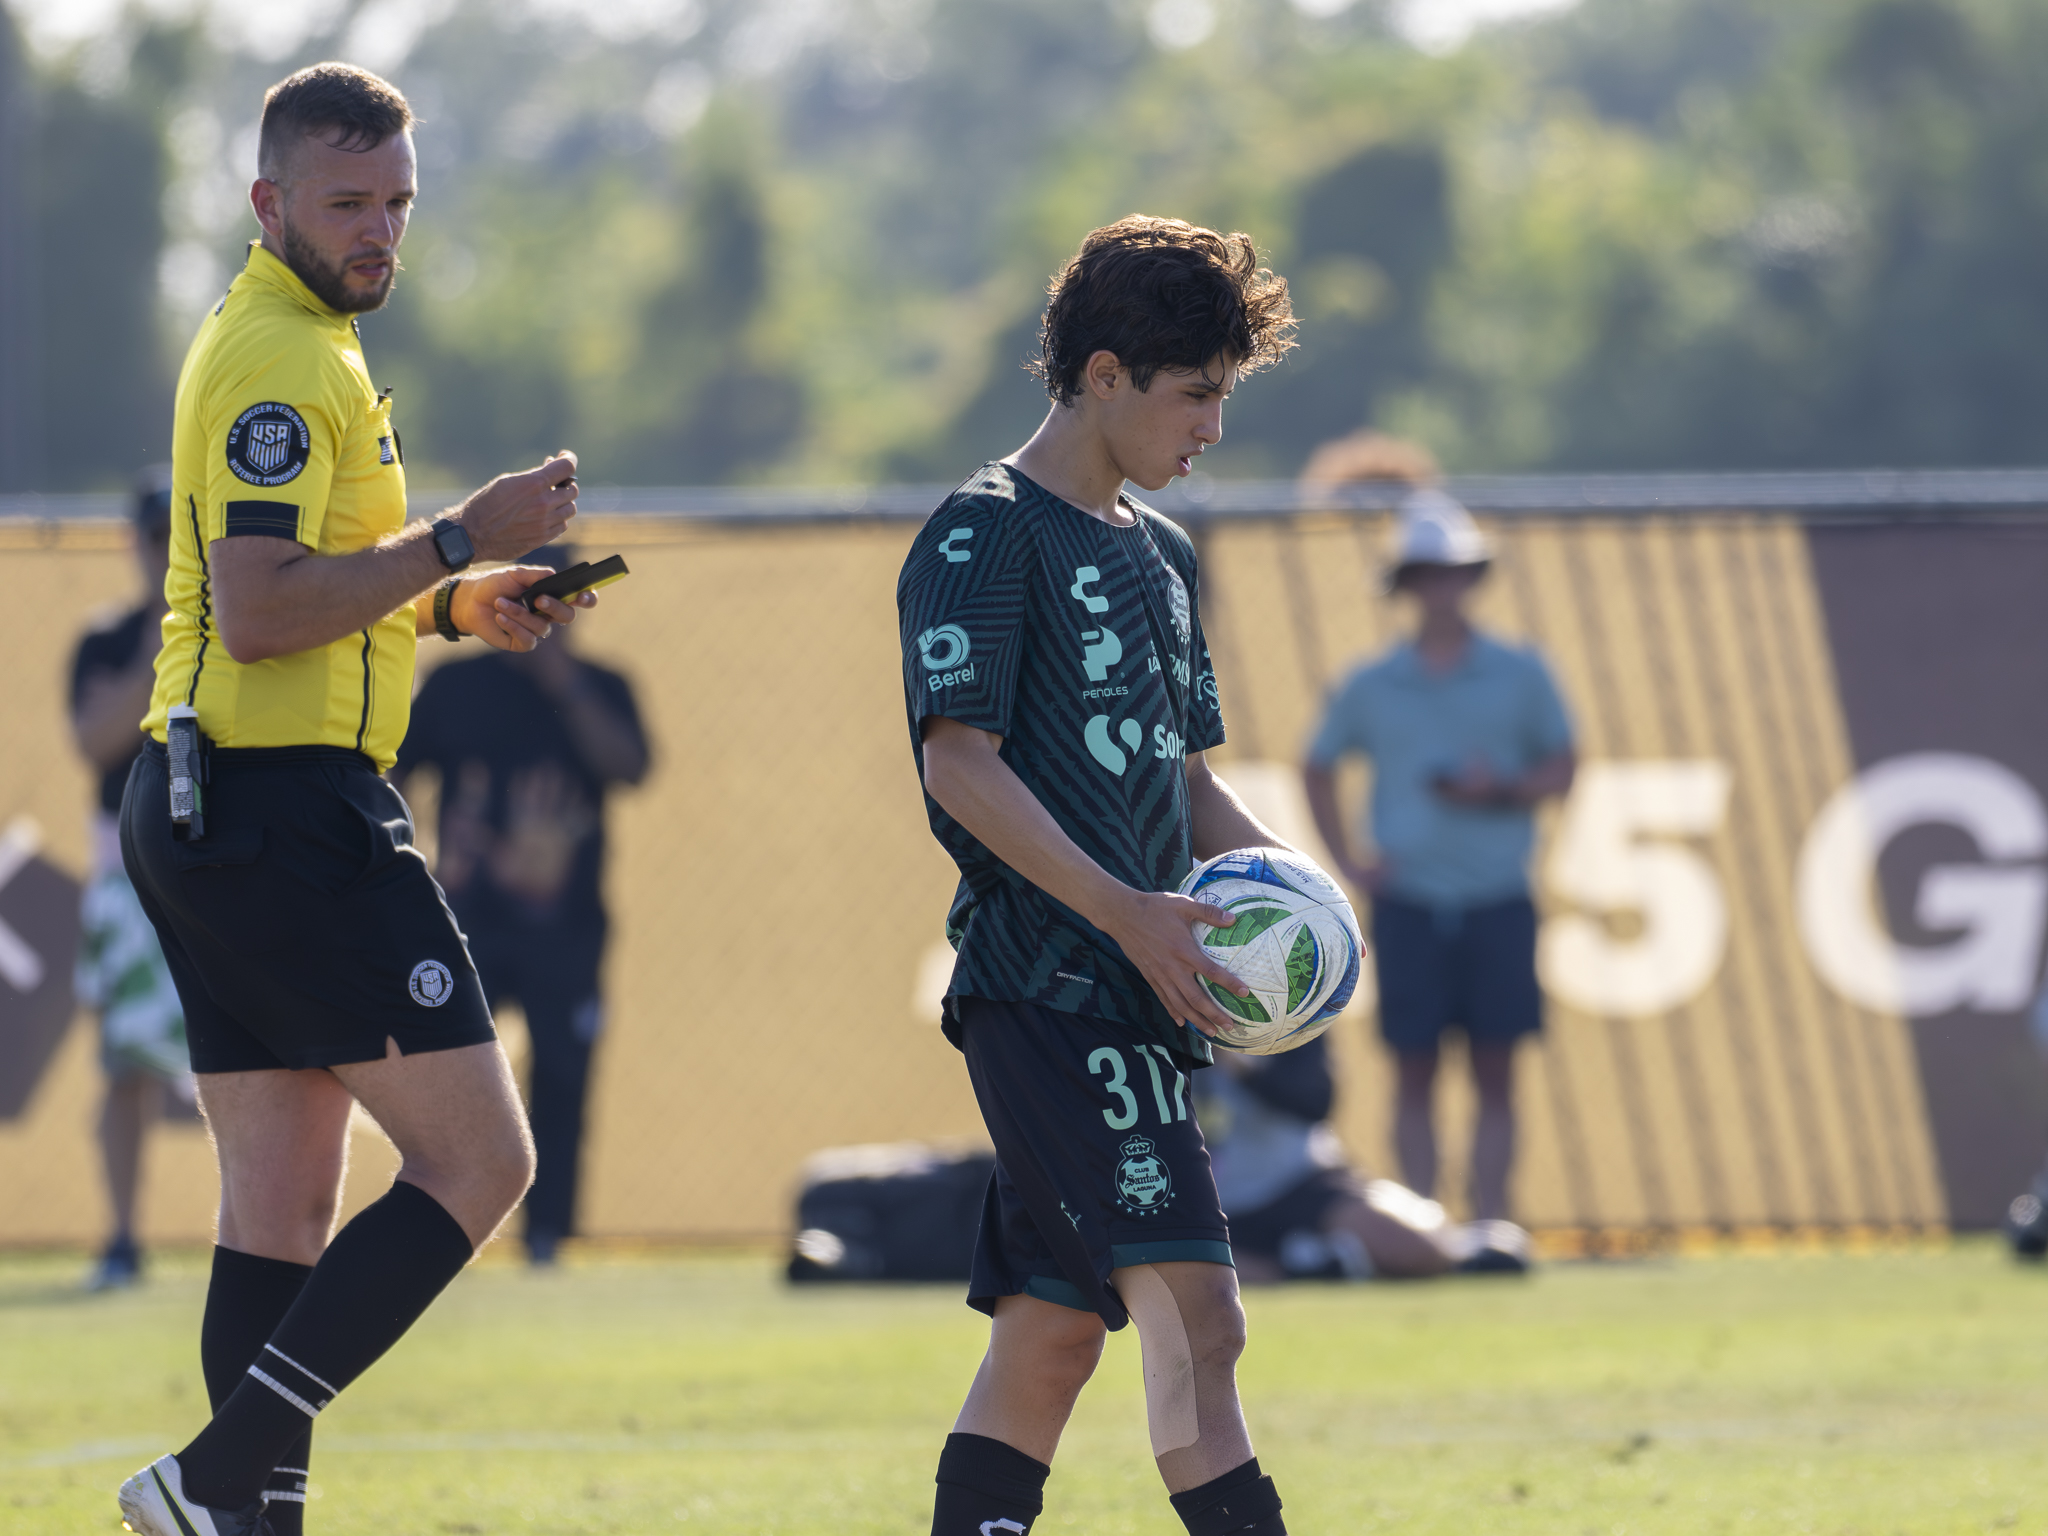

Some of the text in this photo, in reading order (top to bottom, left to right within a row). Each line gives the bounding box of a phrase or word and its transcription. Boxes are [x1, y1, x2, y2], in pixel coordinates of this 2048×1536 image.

[229, 404, 309, 449] U.S. SOCCER FEDERATION
[252, 424, 289, 444] USA
[229, 458, 303, 485] REFEREE PROGRAM
[928, 662, 975, 692] Berel
[423, 972, 439, 984] USA
[1125, 1172, 1160, 1188] Santos
[1133, 1184, 1157, 1194] LAGUNA
